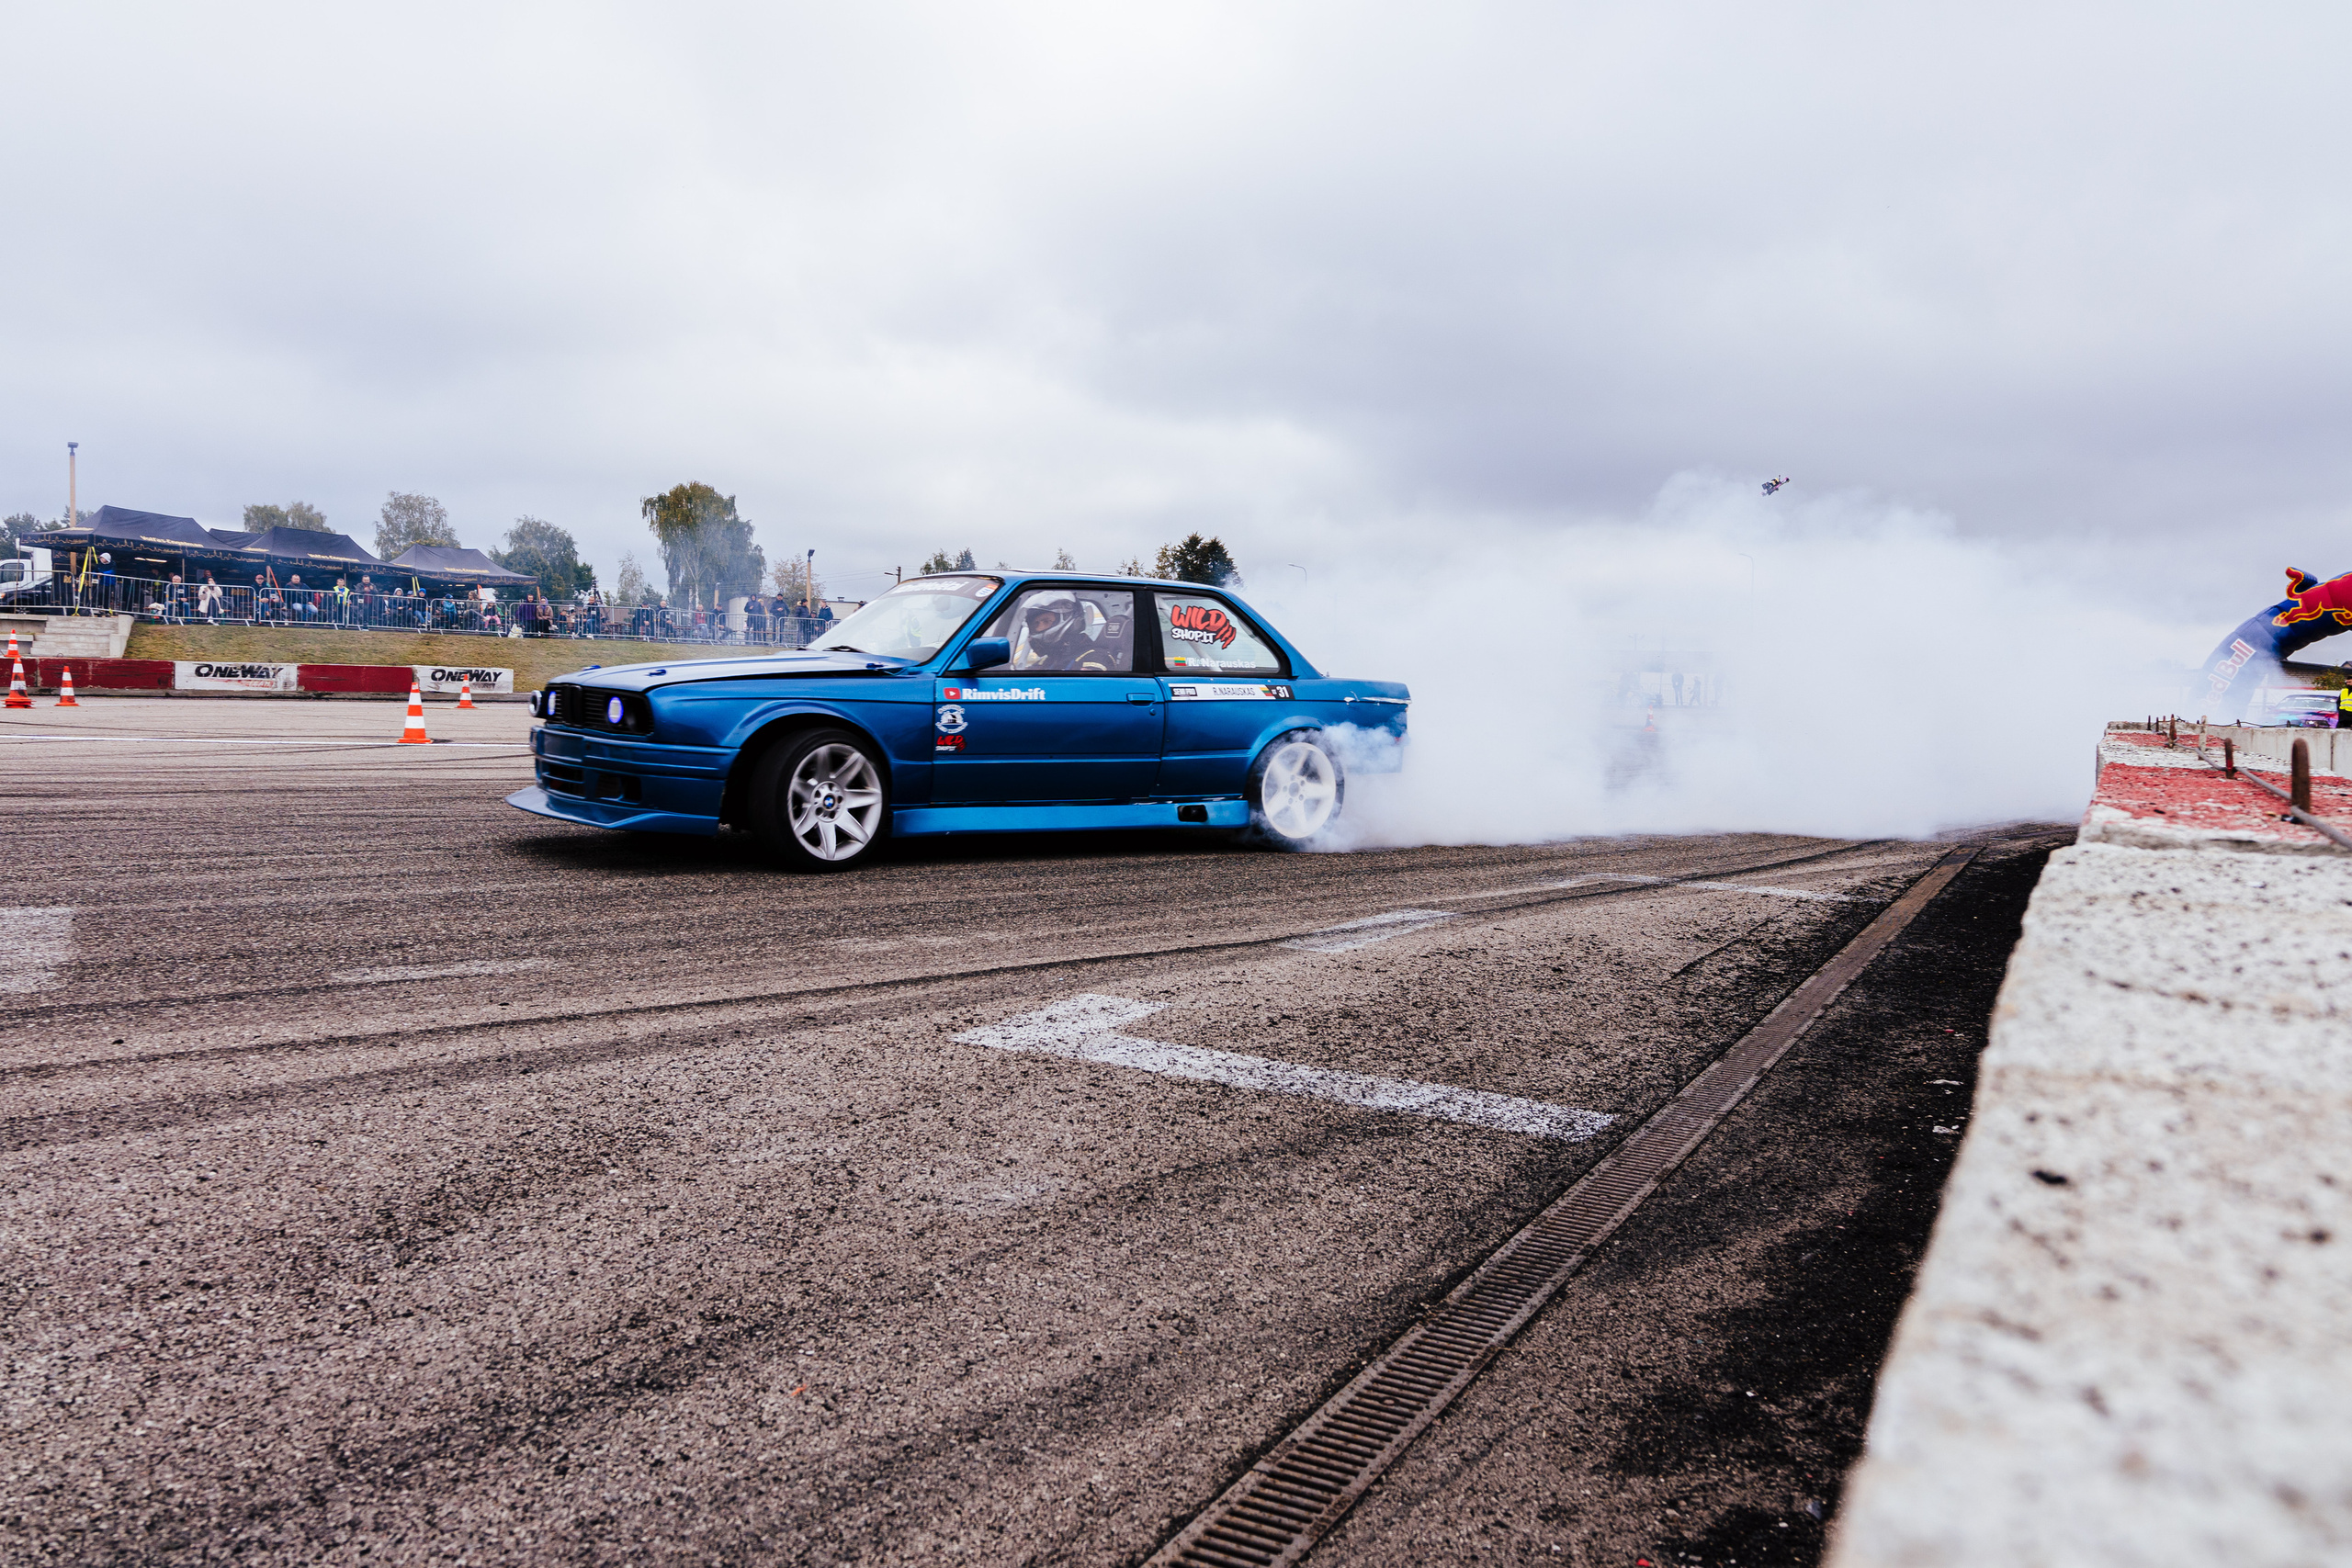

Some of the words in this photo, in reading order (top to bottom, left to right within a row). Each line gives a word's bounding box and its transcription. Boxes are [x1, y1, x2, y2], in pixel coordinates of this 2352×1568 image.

[1171, 605, 1227, 631] WILD
[2213, 637, 2256, 681] Bull
[961, 687, 1046, 701] RimvisDrift
[1275, 686, 1290, 698] 31
